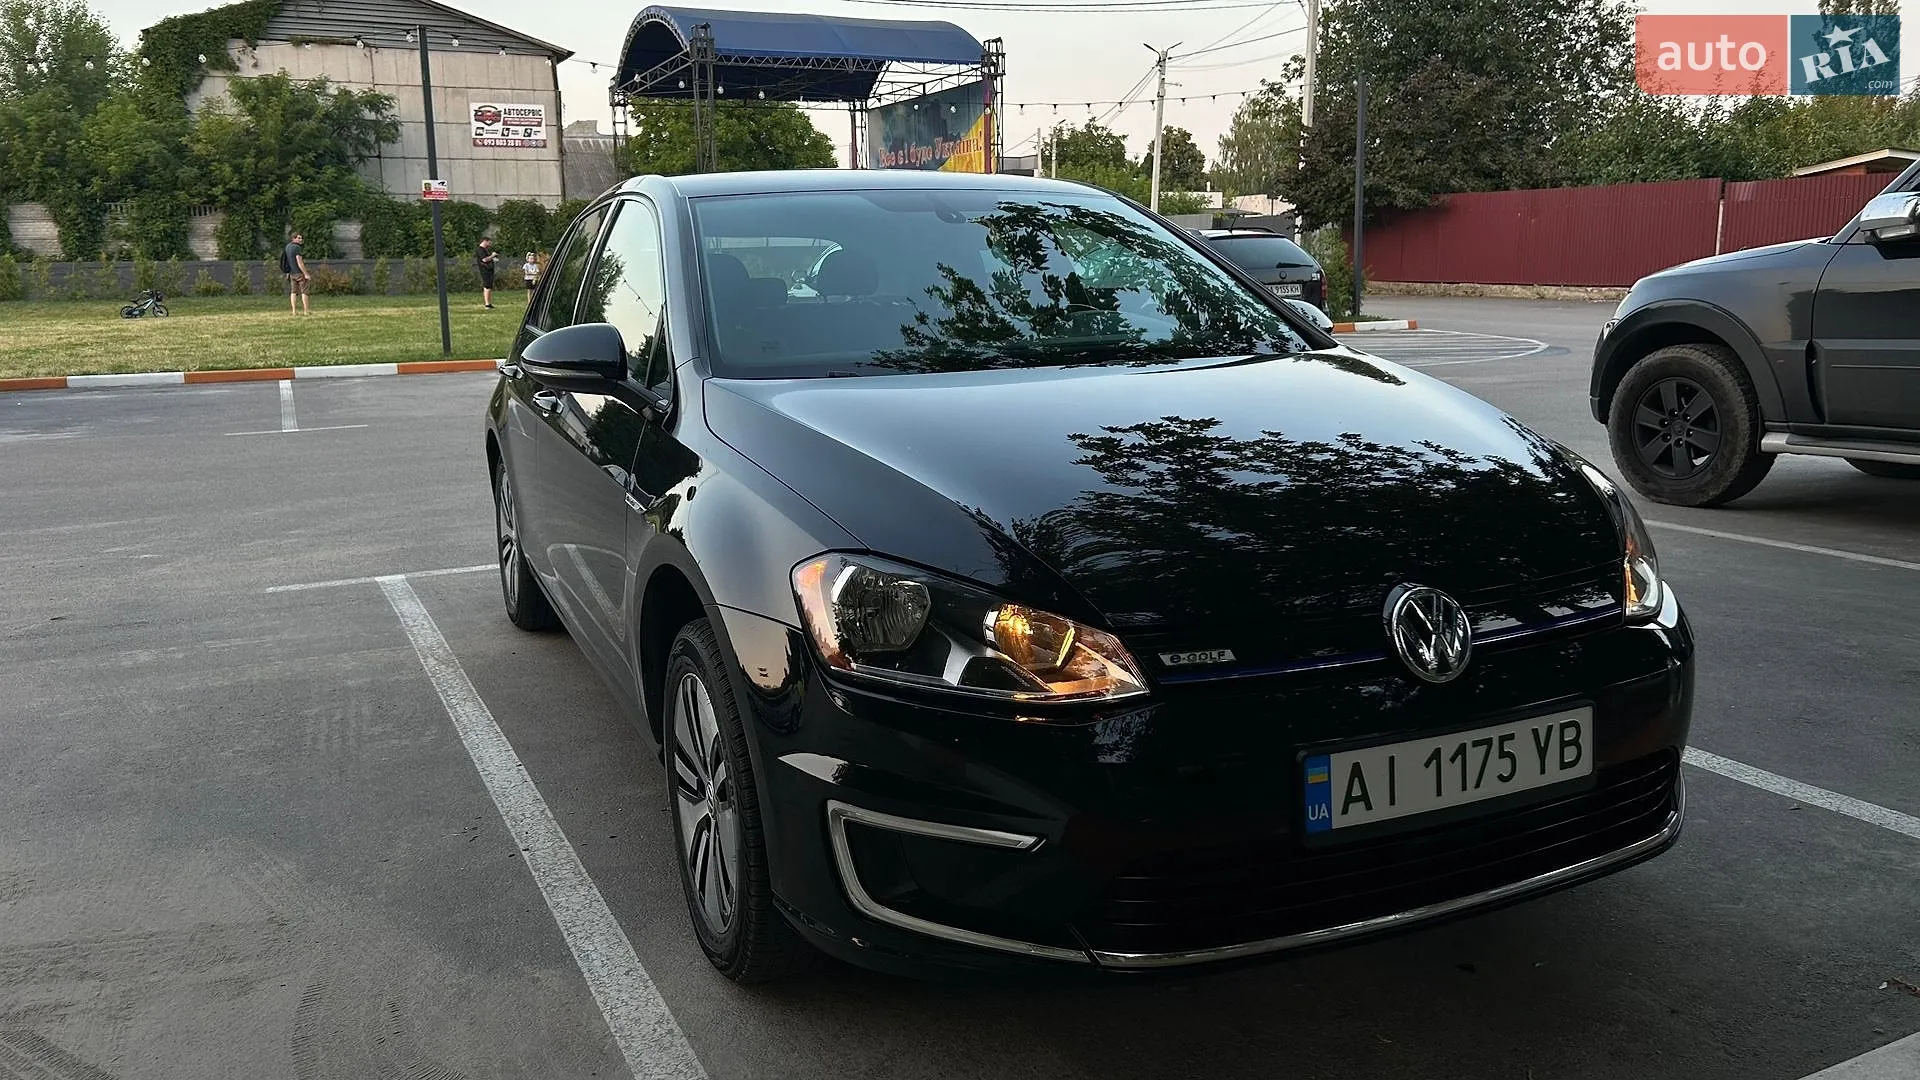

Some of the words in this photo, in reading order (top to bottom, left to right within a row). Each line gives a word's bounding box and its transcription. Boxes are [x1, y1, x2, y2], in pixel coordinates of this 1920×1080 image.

[503, 108, 542, 116] АВТОСЕРВІС
[1341, 755, 1396, 815] AI
[1424, 732, 1517, 797] 1175
[1531, 718, 1583, 776] YB
[1308, 802, 1329, 821] UA
